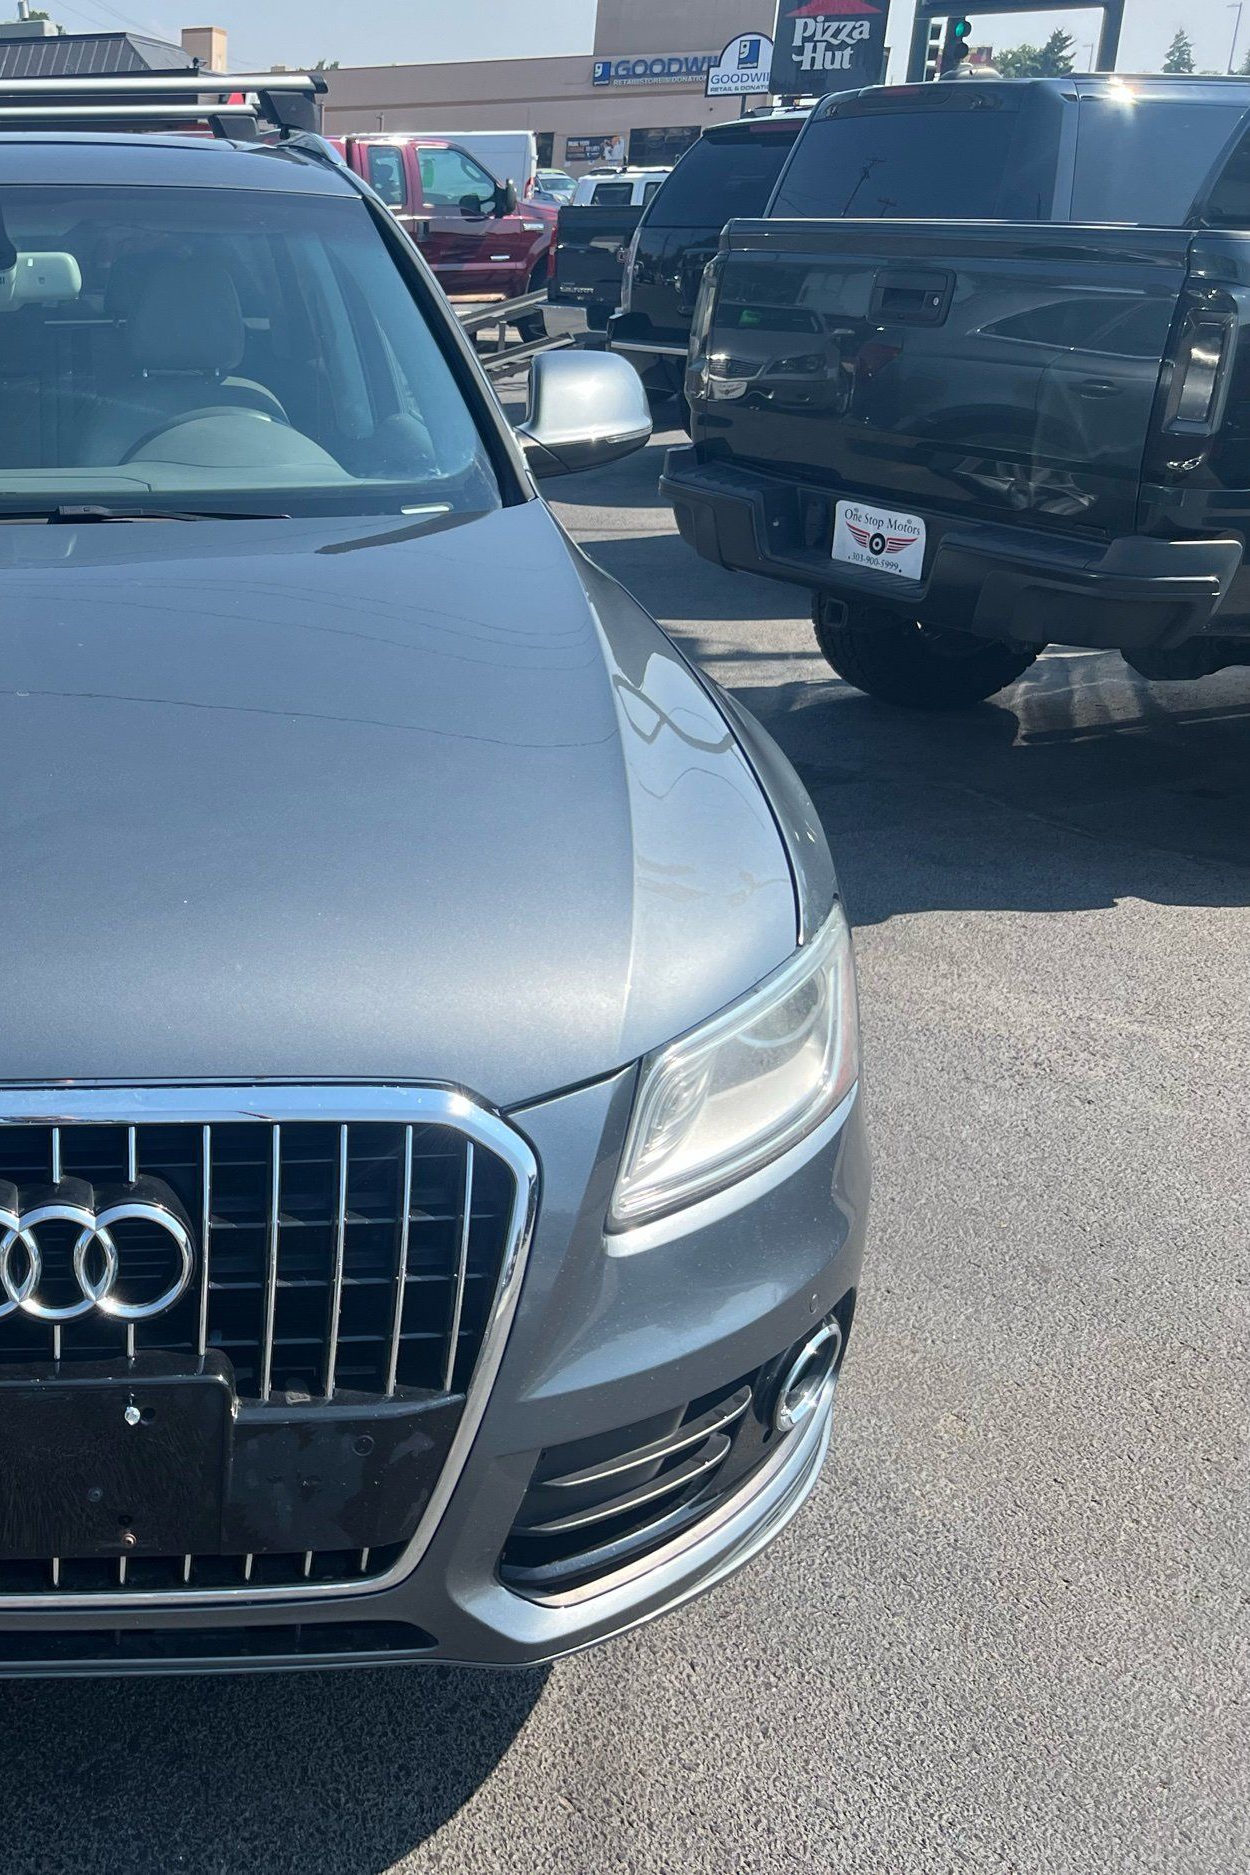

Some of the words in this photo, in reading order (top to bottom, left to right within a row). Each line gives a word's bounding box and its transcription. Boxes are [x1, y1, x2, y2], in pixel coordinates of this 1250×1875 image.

[791, 15, 870, 46] Pizza
[791, 42, 854, 70] Hut
[844, 508, 862, 522] One
[864, 513, 884, 529] Stop
[886, 518, 921, 536] Motors
[851, 552, 899, 570] 303-900-5999
